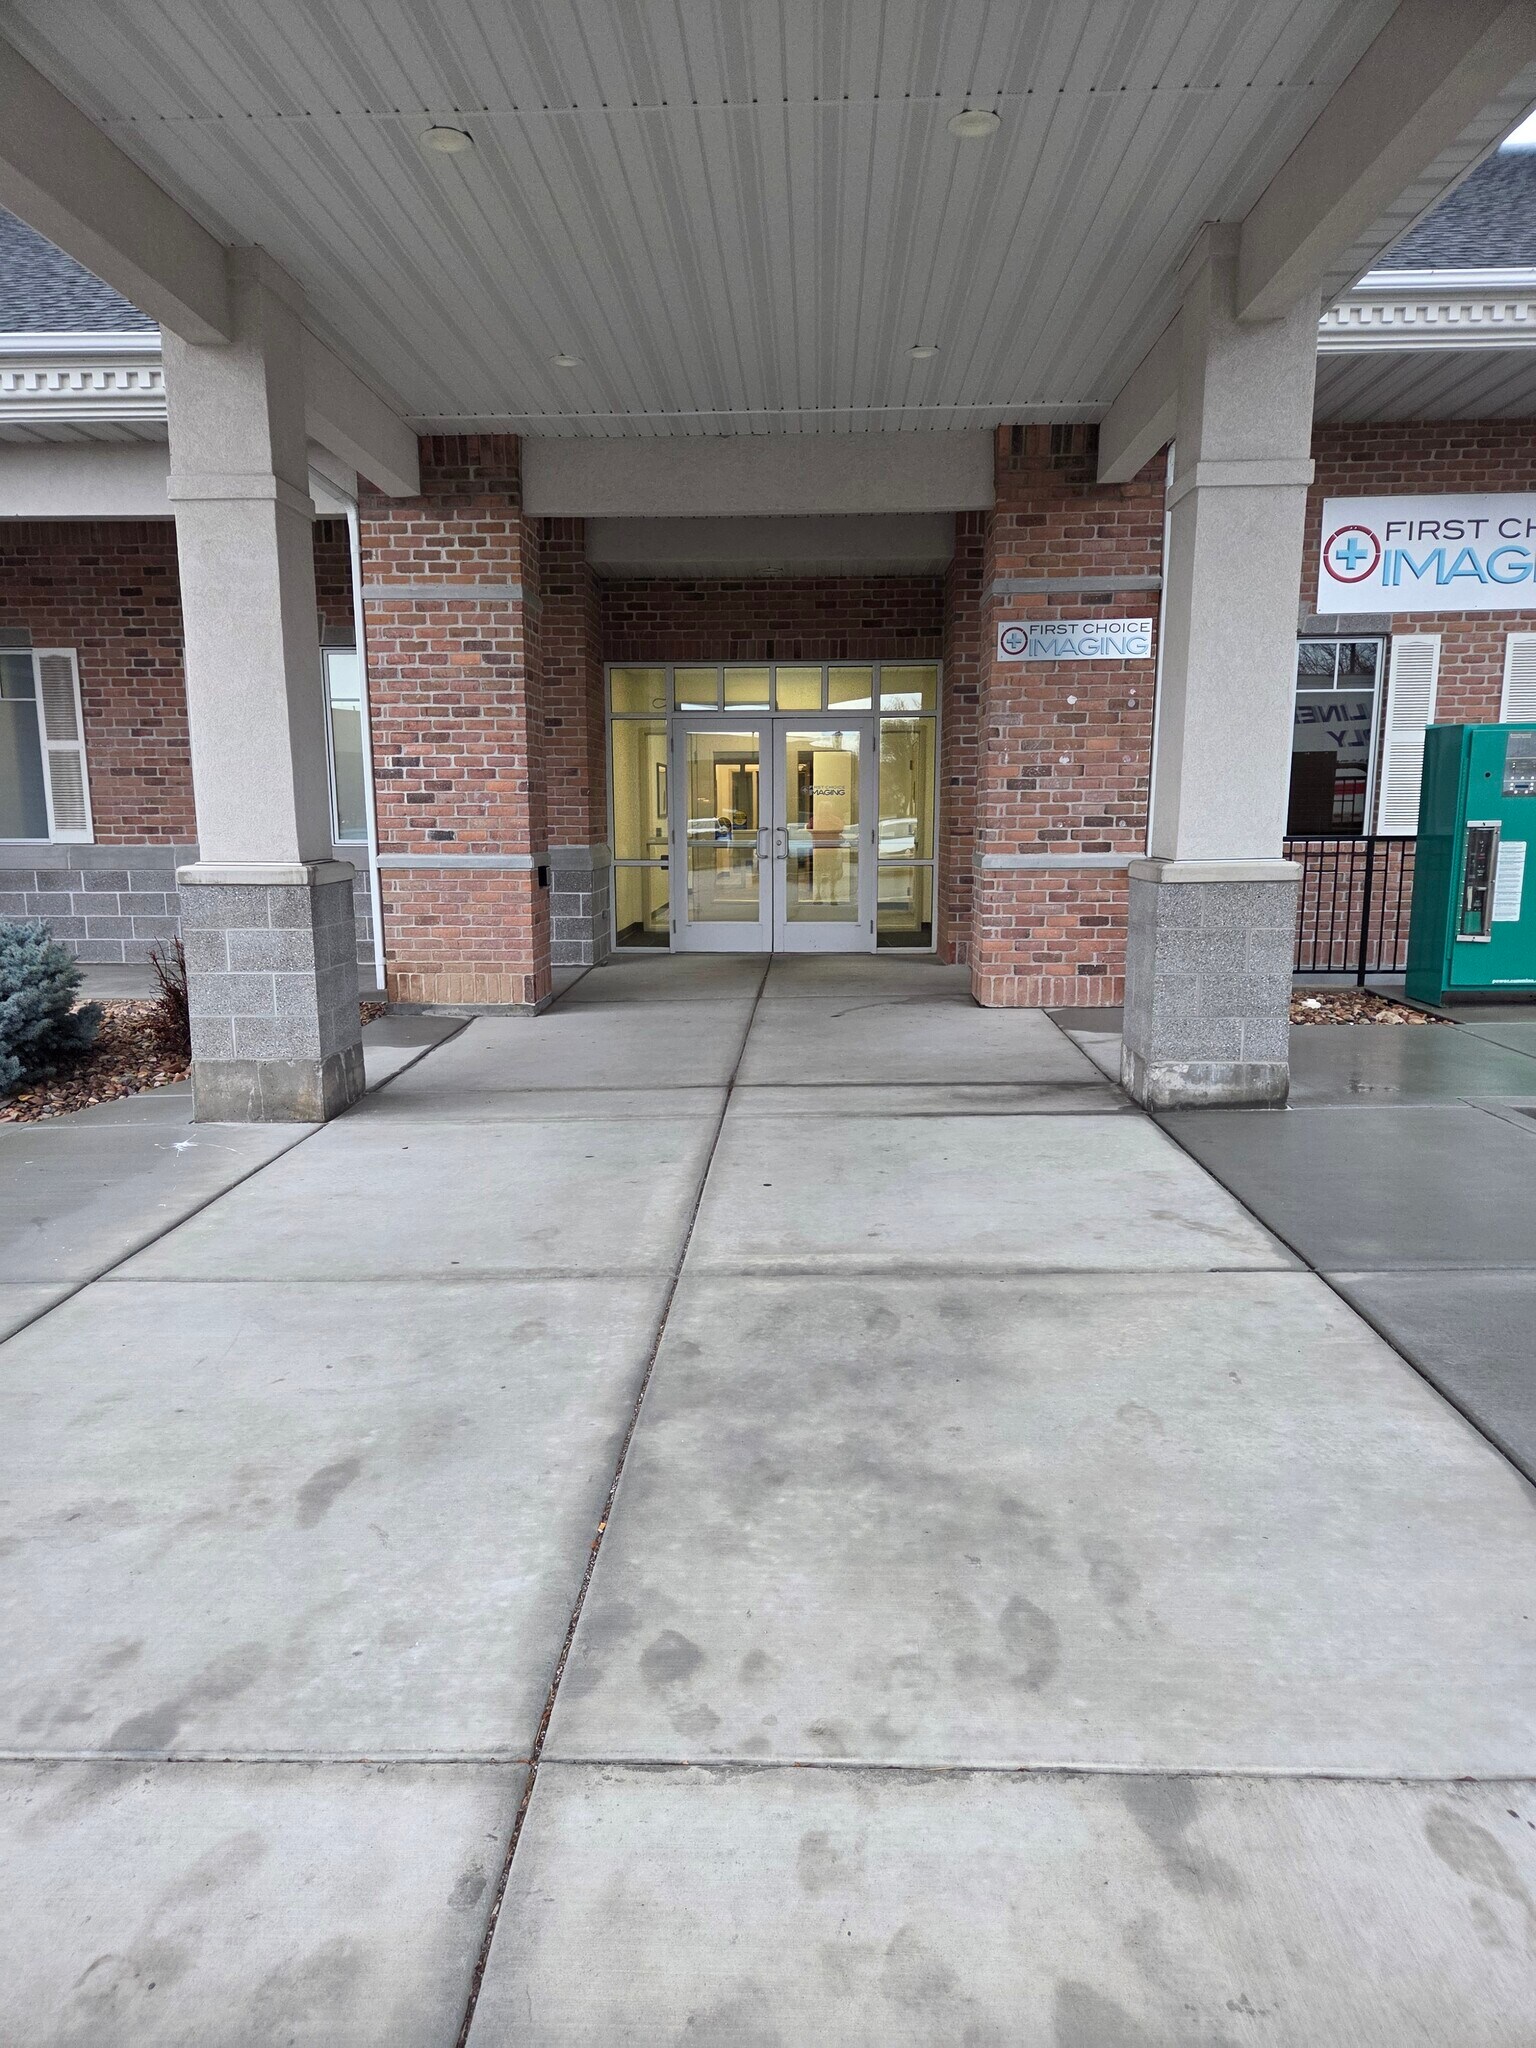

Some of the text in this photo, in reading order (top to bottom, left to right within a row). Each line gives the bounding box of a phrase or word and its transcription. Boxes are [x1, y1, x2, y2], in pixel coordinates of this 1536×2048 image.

[1385, 518, 1490, 542] FIRST
[1381, 544, 1536, 587] IMAG
[1029, 622, 1151, 635] FIRST CHOICE
[1028, 636, 1149, 657] IMAGING
